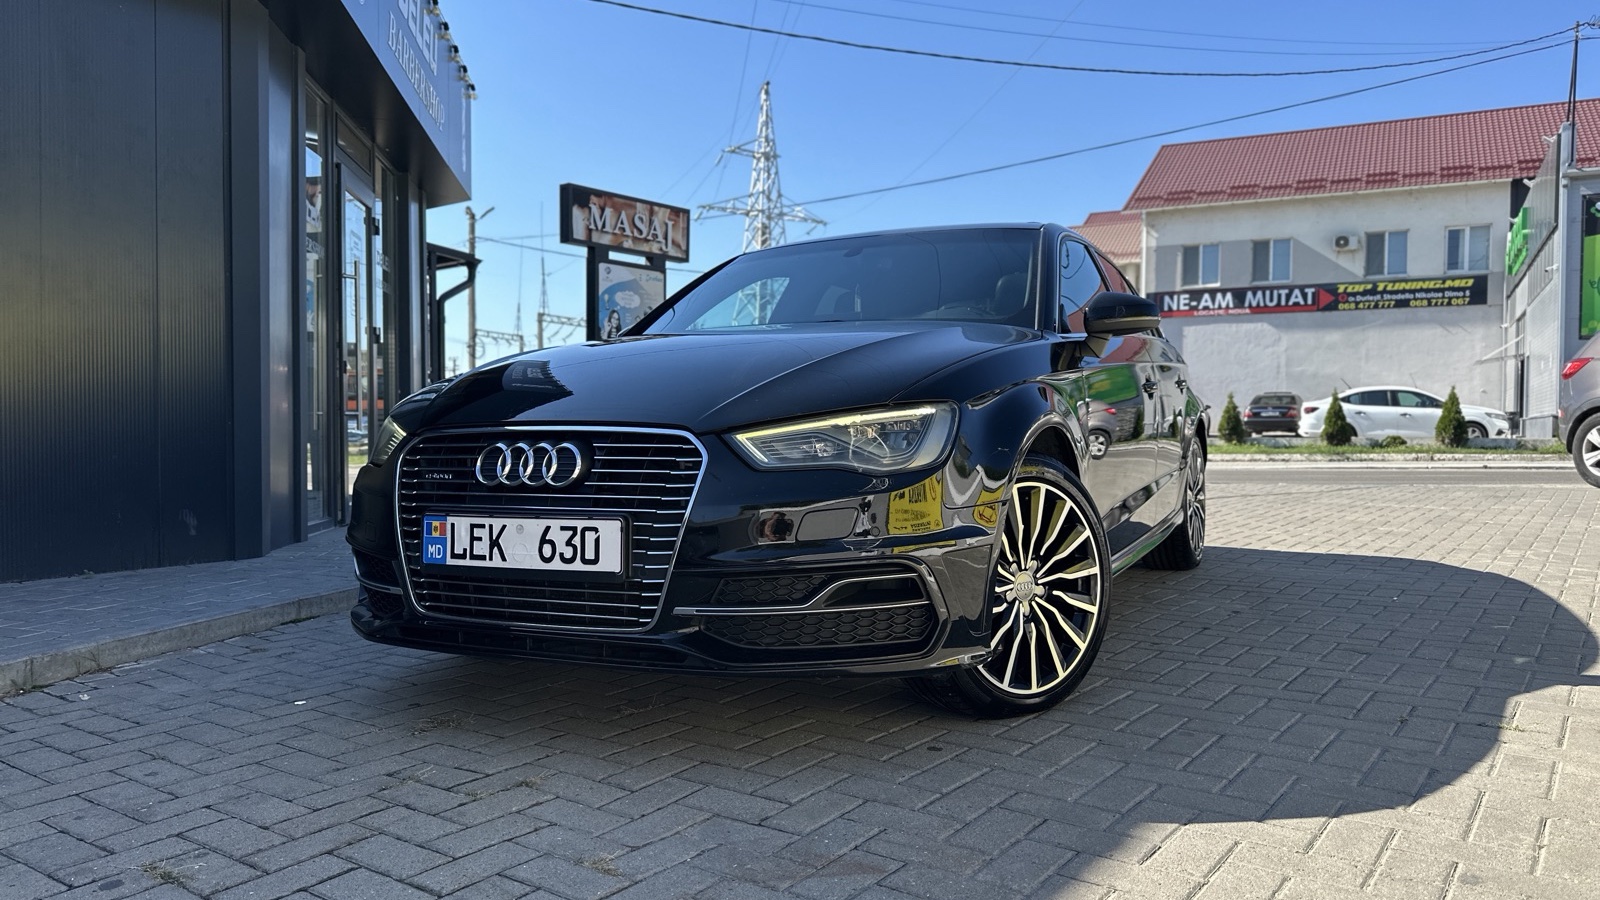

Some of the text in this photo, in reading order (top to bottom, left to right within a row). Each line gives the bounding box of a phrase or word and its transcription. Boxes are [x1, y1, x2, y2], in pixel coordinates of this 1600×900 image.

[387, 10, 445, 132] BARBERSHOP
[588, 203, 675, 252] MASAJ
[1337, 278, 1475, 293] TOP TUNING.MD
[1163, 288, 1316, 311] NE-AM MUTAT
[1338, 302, 1355, 310] 068
[1410, 299, 1428, 307] 068
[1430, 298, 1448, 306] 777
[428, 544, 442, 559] MD
[450, 522, 601, 565] LEK 630
